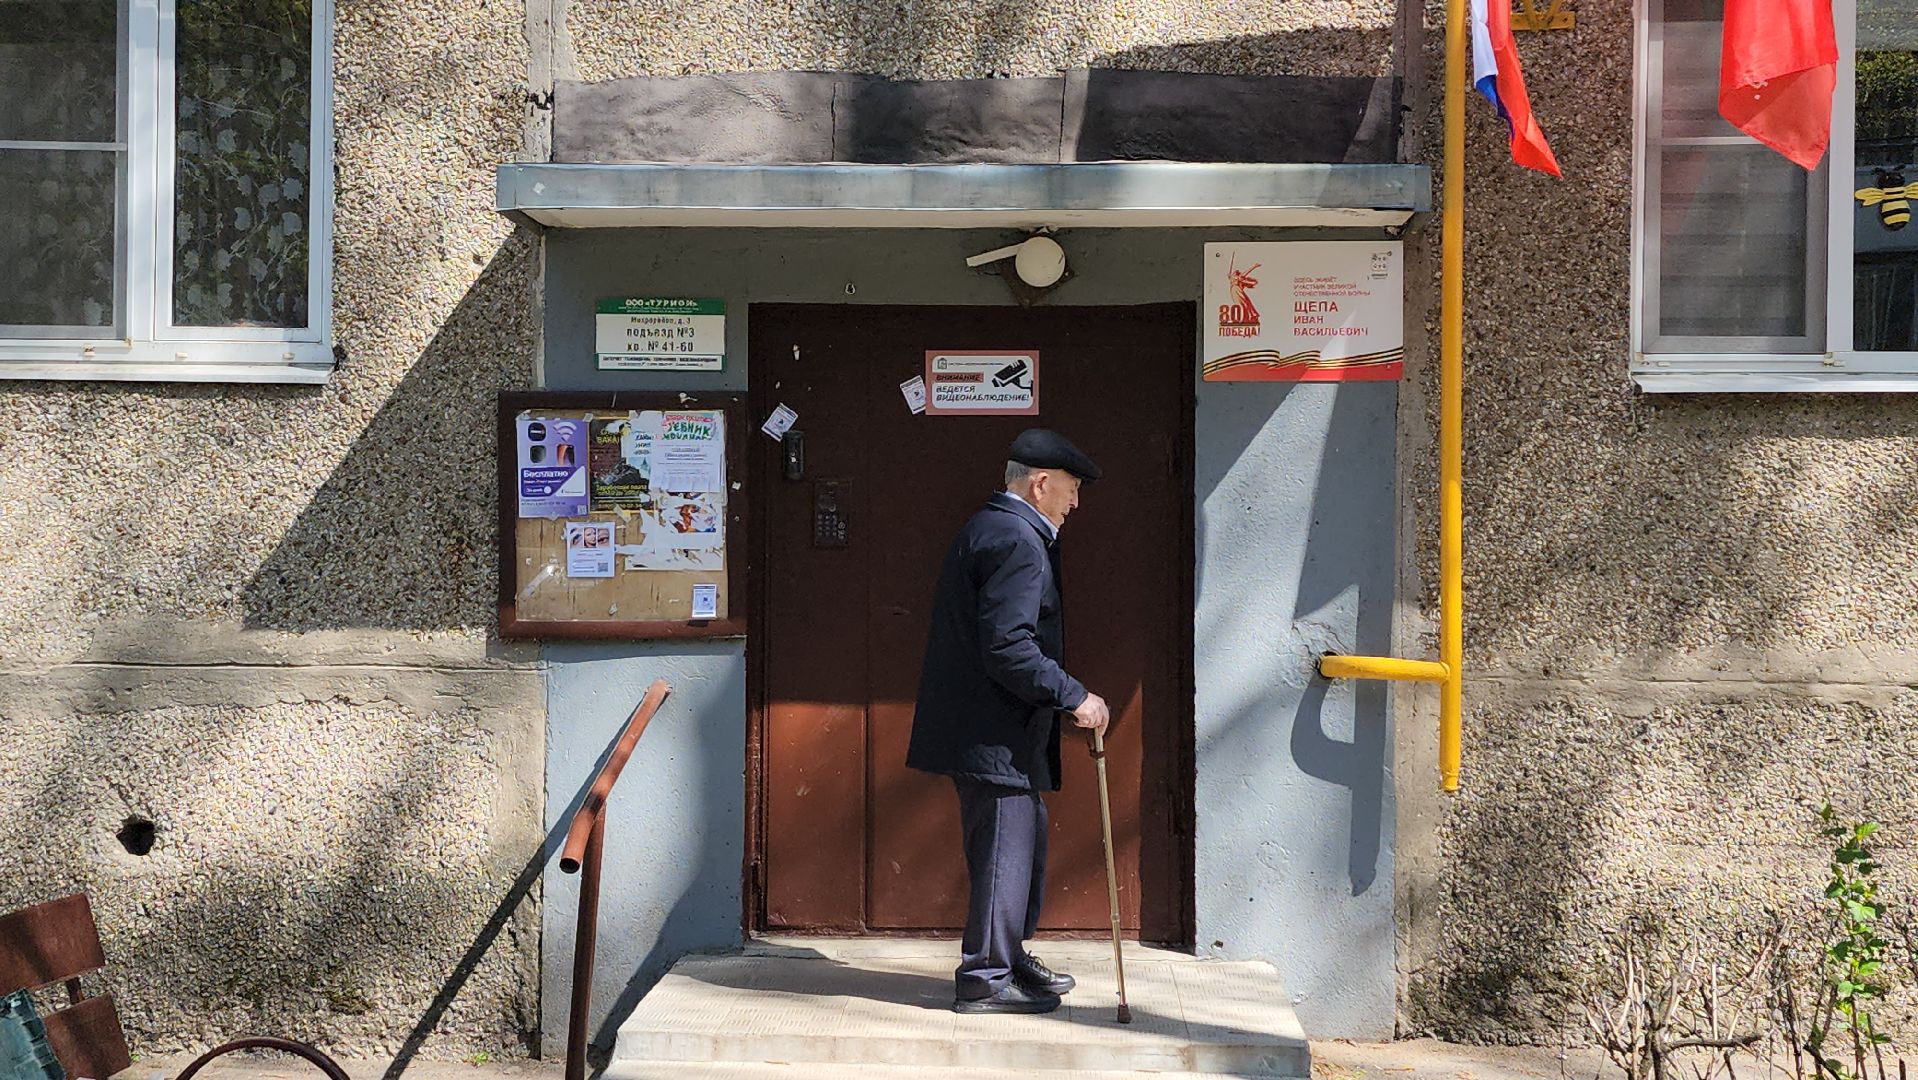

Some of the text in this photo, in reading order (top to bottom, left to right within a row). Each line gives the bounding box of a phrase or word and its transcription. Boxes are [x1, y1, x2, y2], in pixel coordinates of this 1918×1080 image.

[1294, 301, 1338, 314] ЩЕПА
[1219, 305, 1243, 322] 80
[1293, 316, 1324, 324] ИВАН
[626, 328, 674, 339] подъезд
[1218, 327, 1261, 338] ПОБЕДА!
[1293, 328, 1369, 336] ВАСИЛЬЕВИЧ
[661, 342, 694, 352] 41-60
[936, 394, 1030, 402] ВИДЕОНАБЛЮДЕНИЕ!
[523, 470, 569, 479] Бесплатно
